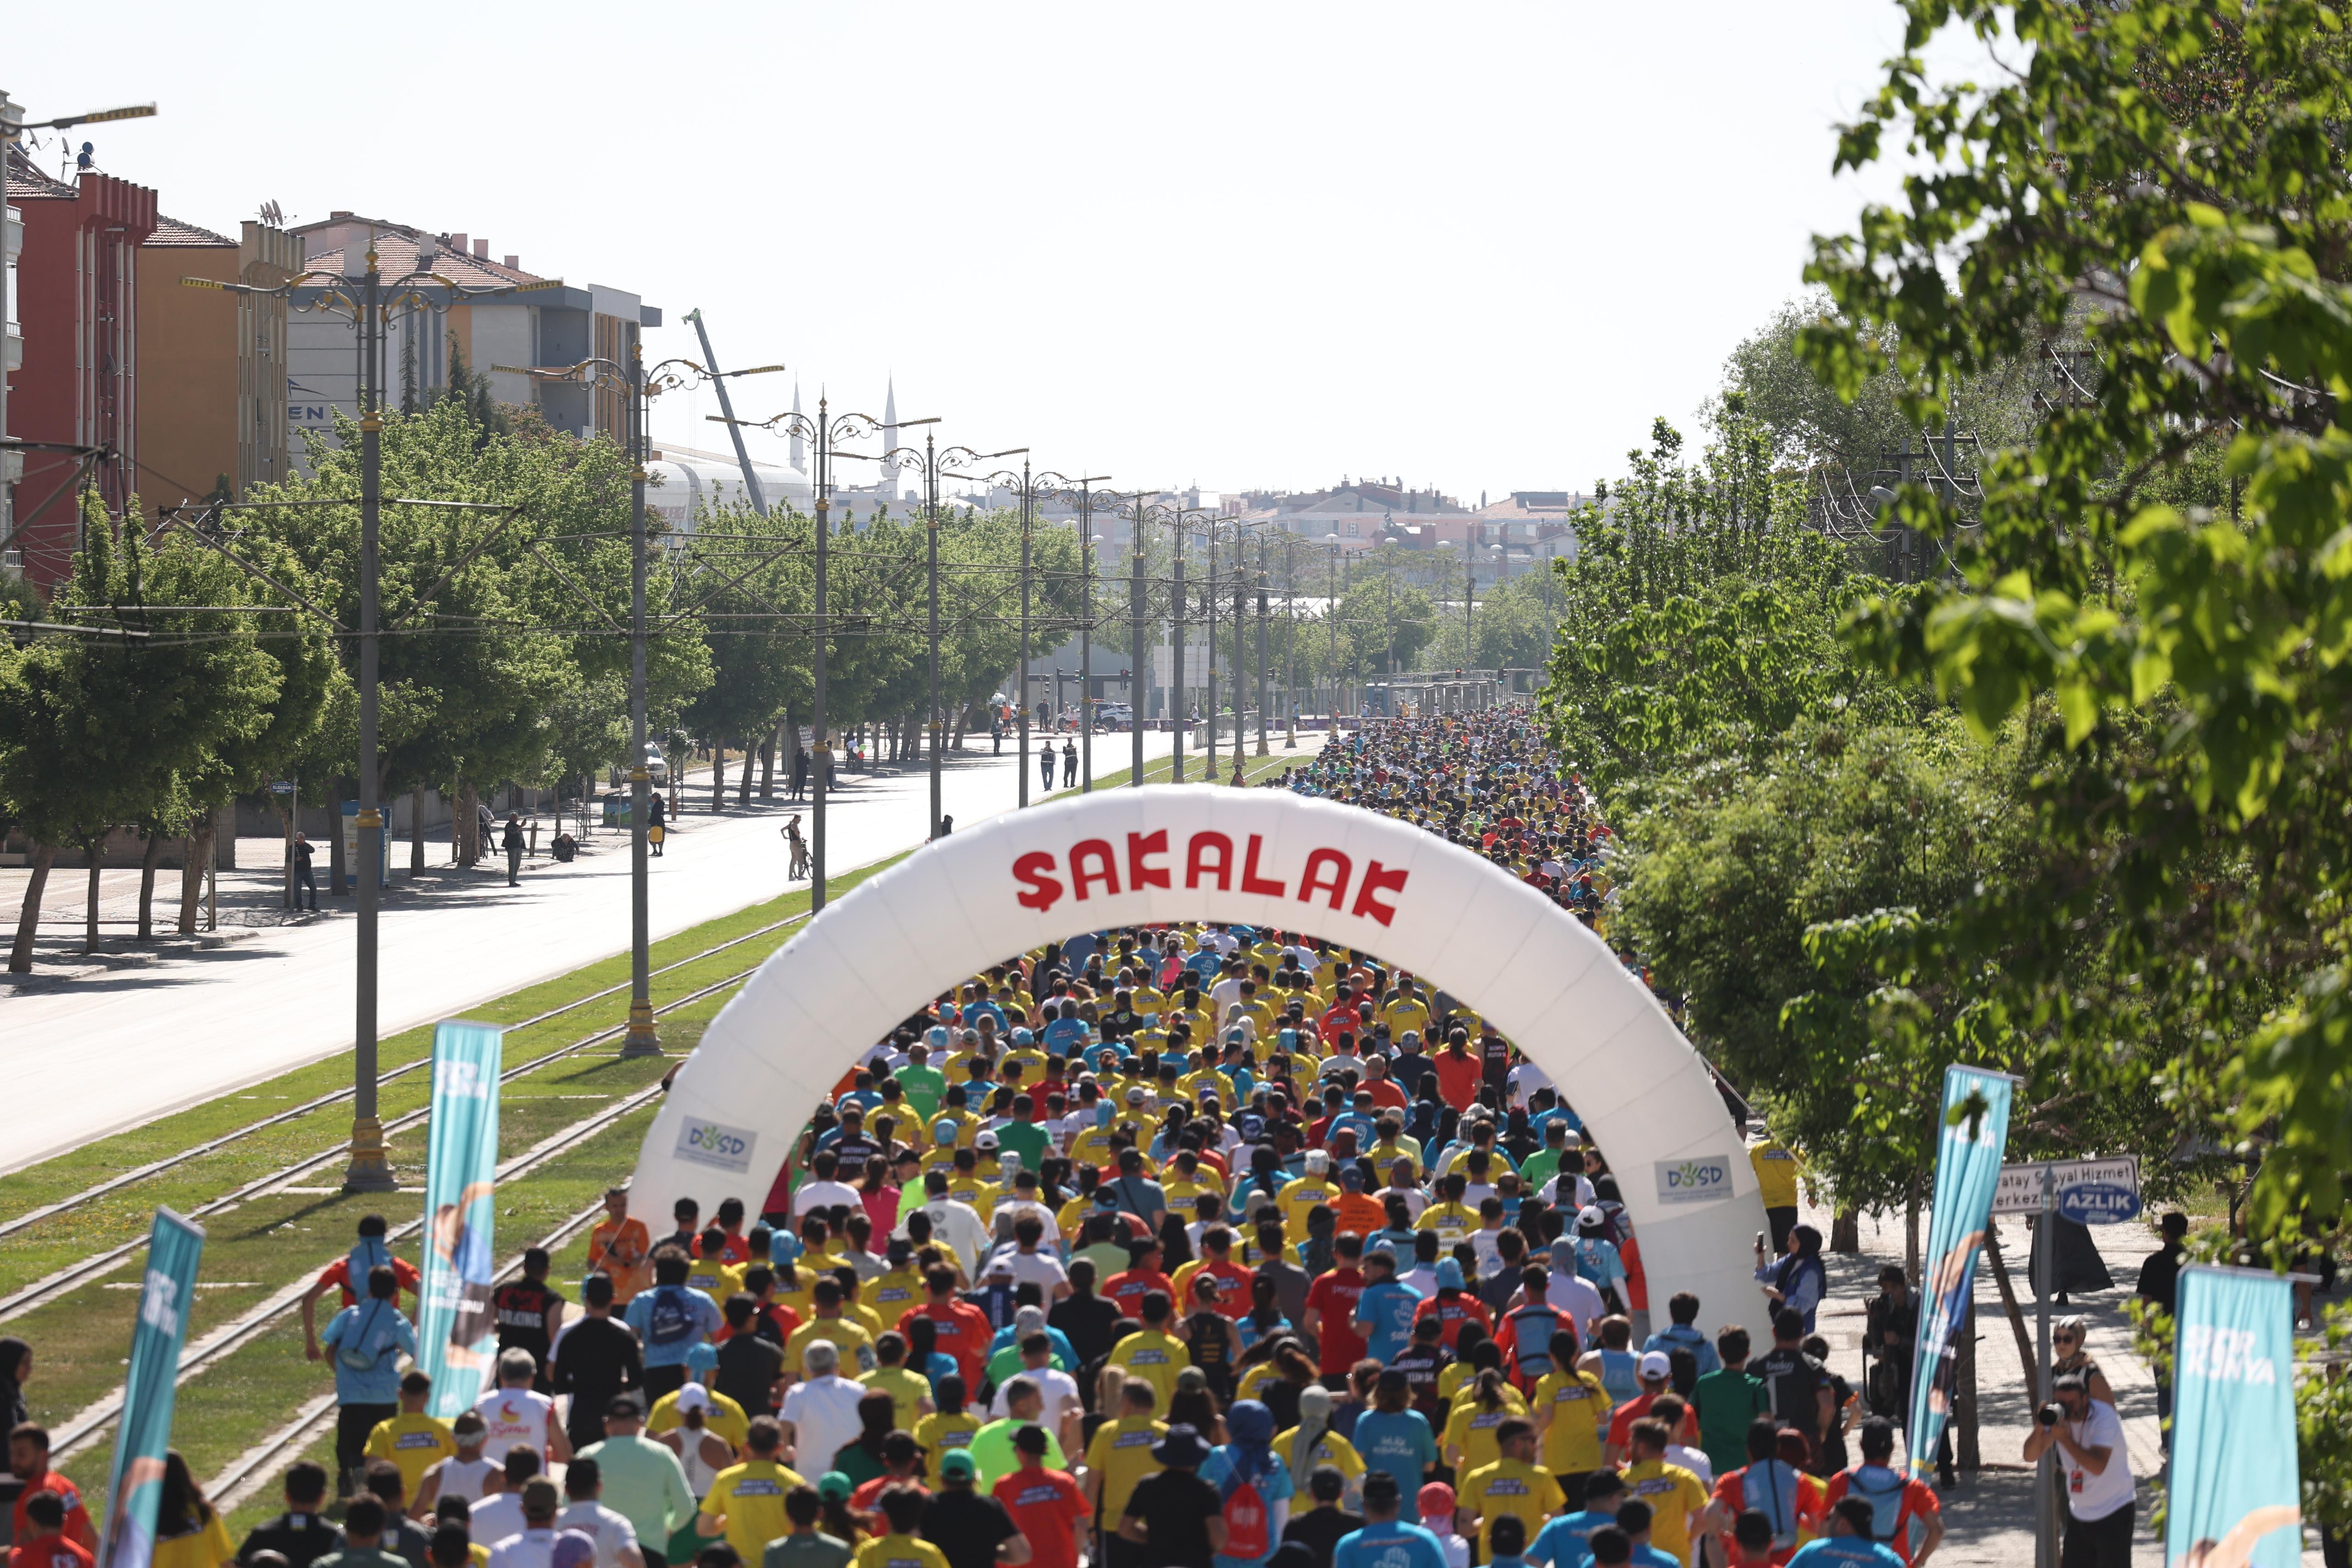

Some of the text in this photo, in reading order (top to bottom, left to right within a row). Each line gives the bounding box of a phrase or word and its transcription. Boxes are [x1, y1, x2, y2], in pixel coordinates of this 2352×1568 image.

[2081, 1165, 2130, 1181] Hizmet
[2066, 1192, 2132, 1211] AZLIK
[1765, 1358, 1795, 1372] beko
